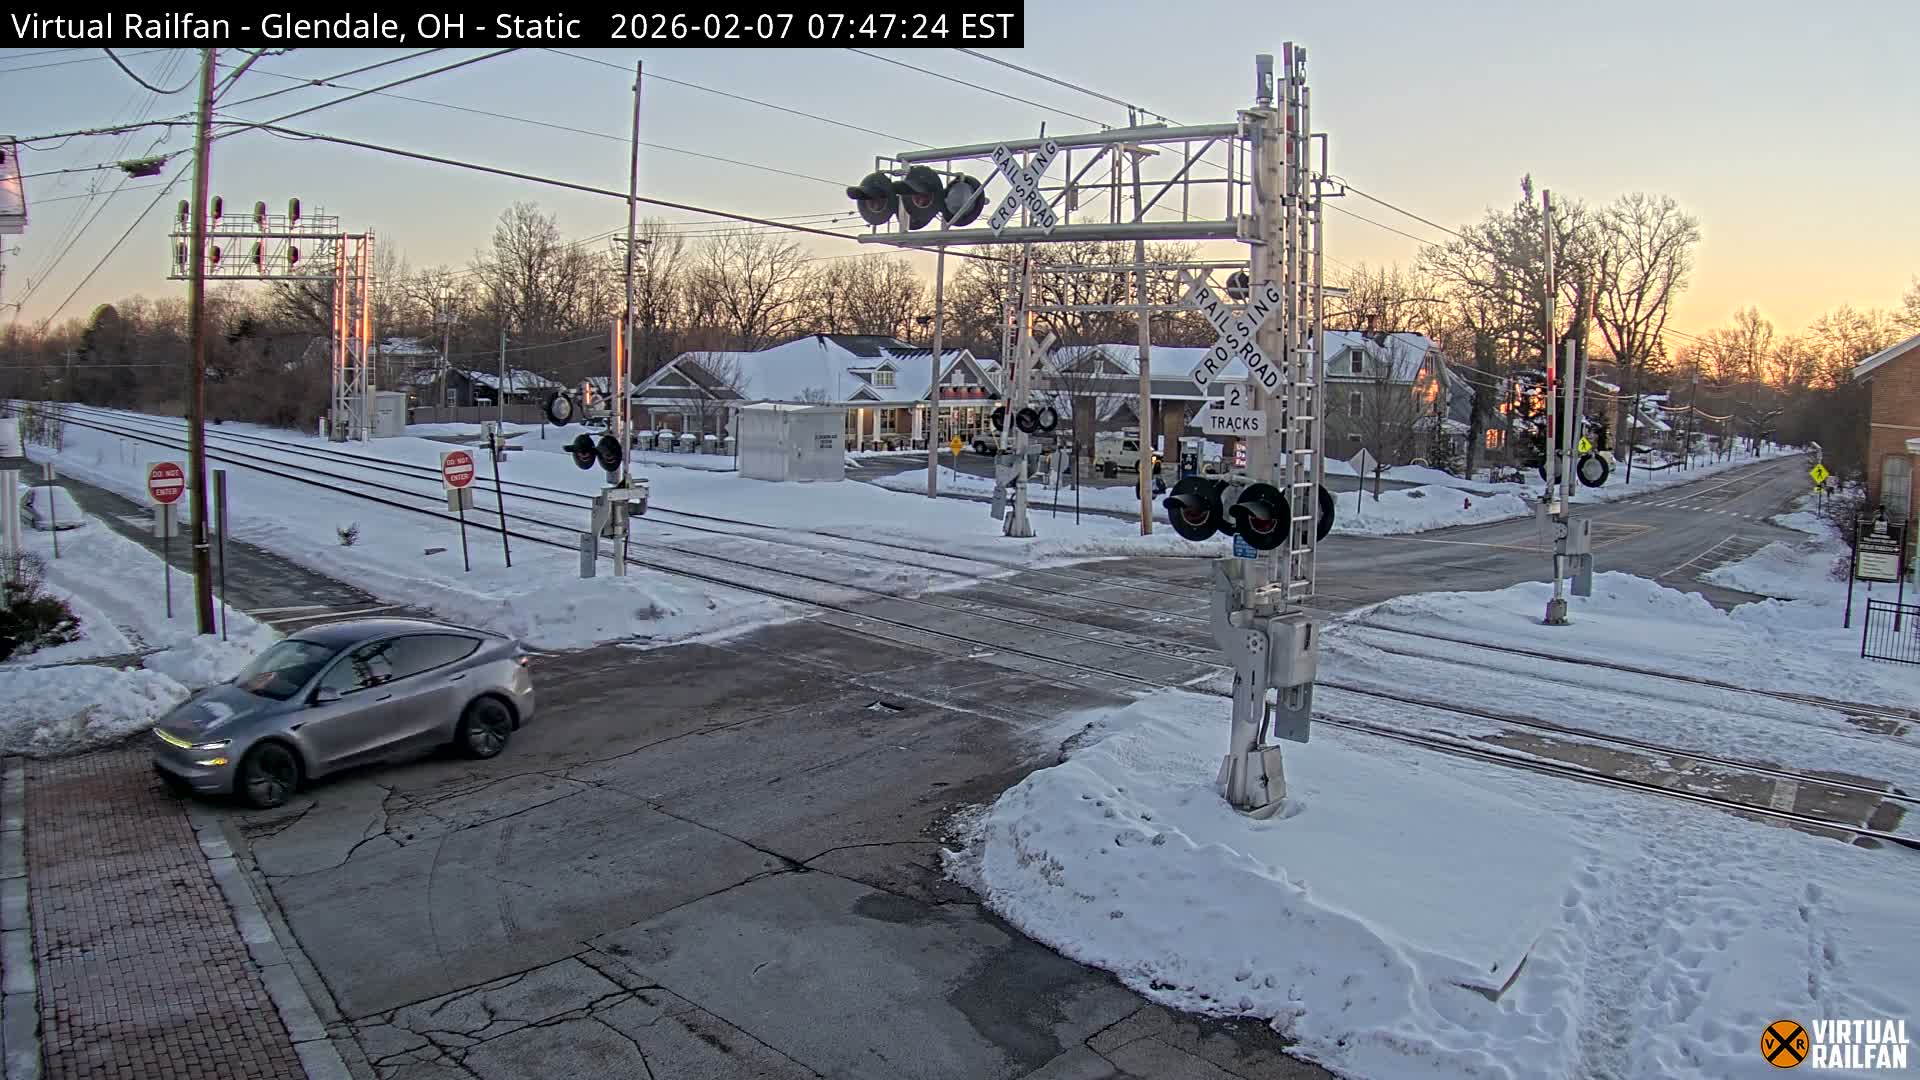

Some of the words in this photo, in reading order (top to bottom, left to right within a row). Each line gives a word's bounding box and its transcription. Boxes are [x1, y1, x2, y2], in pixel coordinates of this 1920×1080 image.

[991, 142, 1056, 230] CROSSING
[993, 146, 1054, 228] RAILROAD
[1194, 287, 1280, 385] CROSSING
[1196, 287, 1278, 388] RAILROAD
[1230, 388, 1241, 406] 2
[1210, 415, 1259, 431] TRACKS
[152, 470, 163, 478] DO
[165, 469, 180, 477] NOT
[450, 473, 469, 482] ENTER
[155, 487, 178, 496] ENTER
